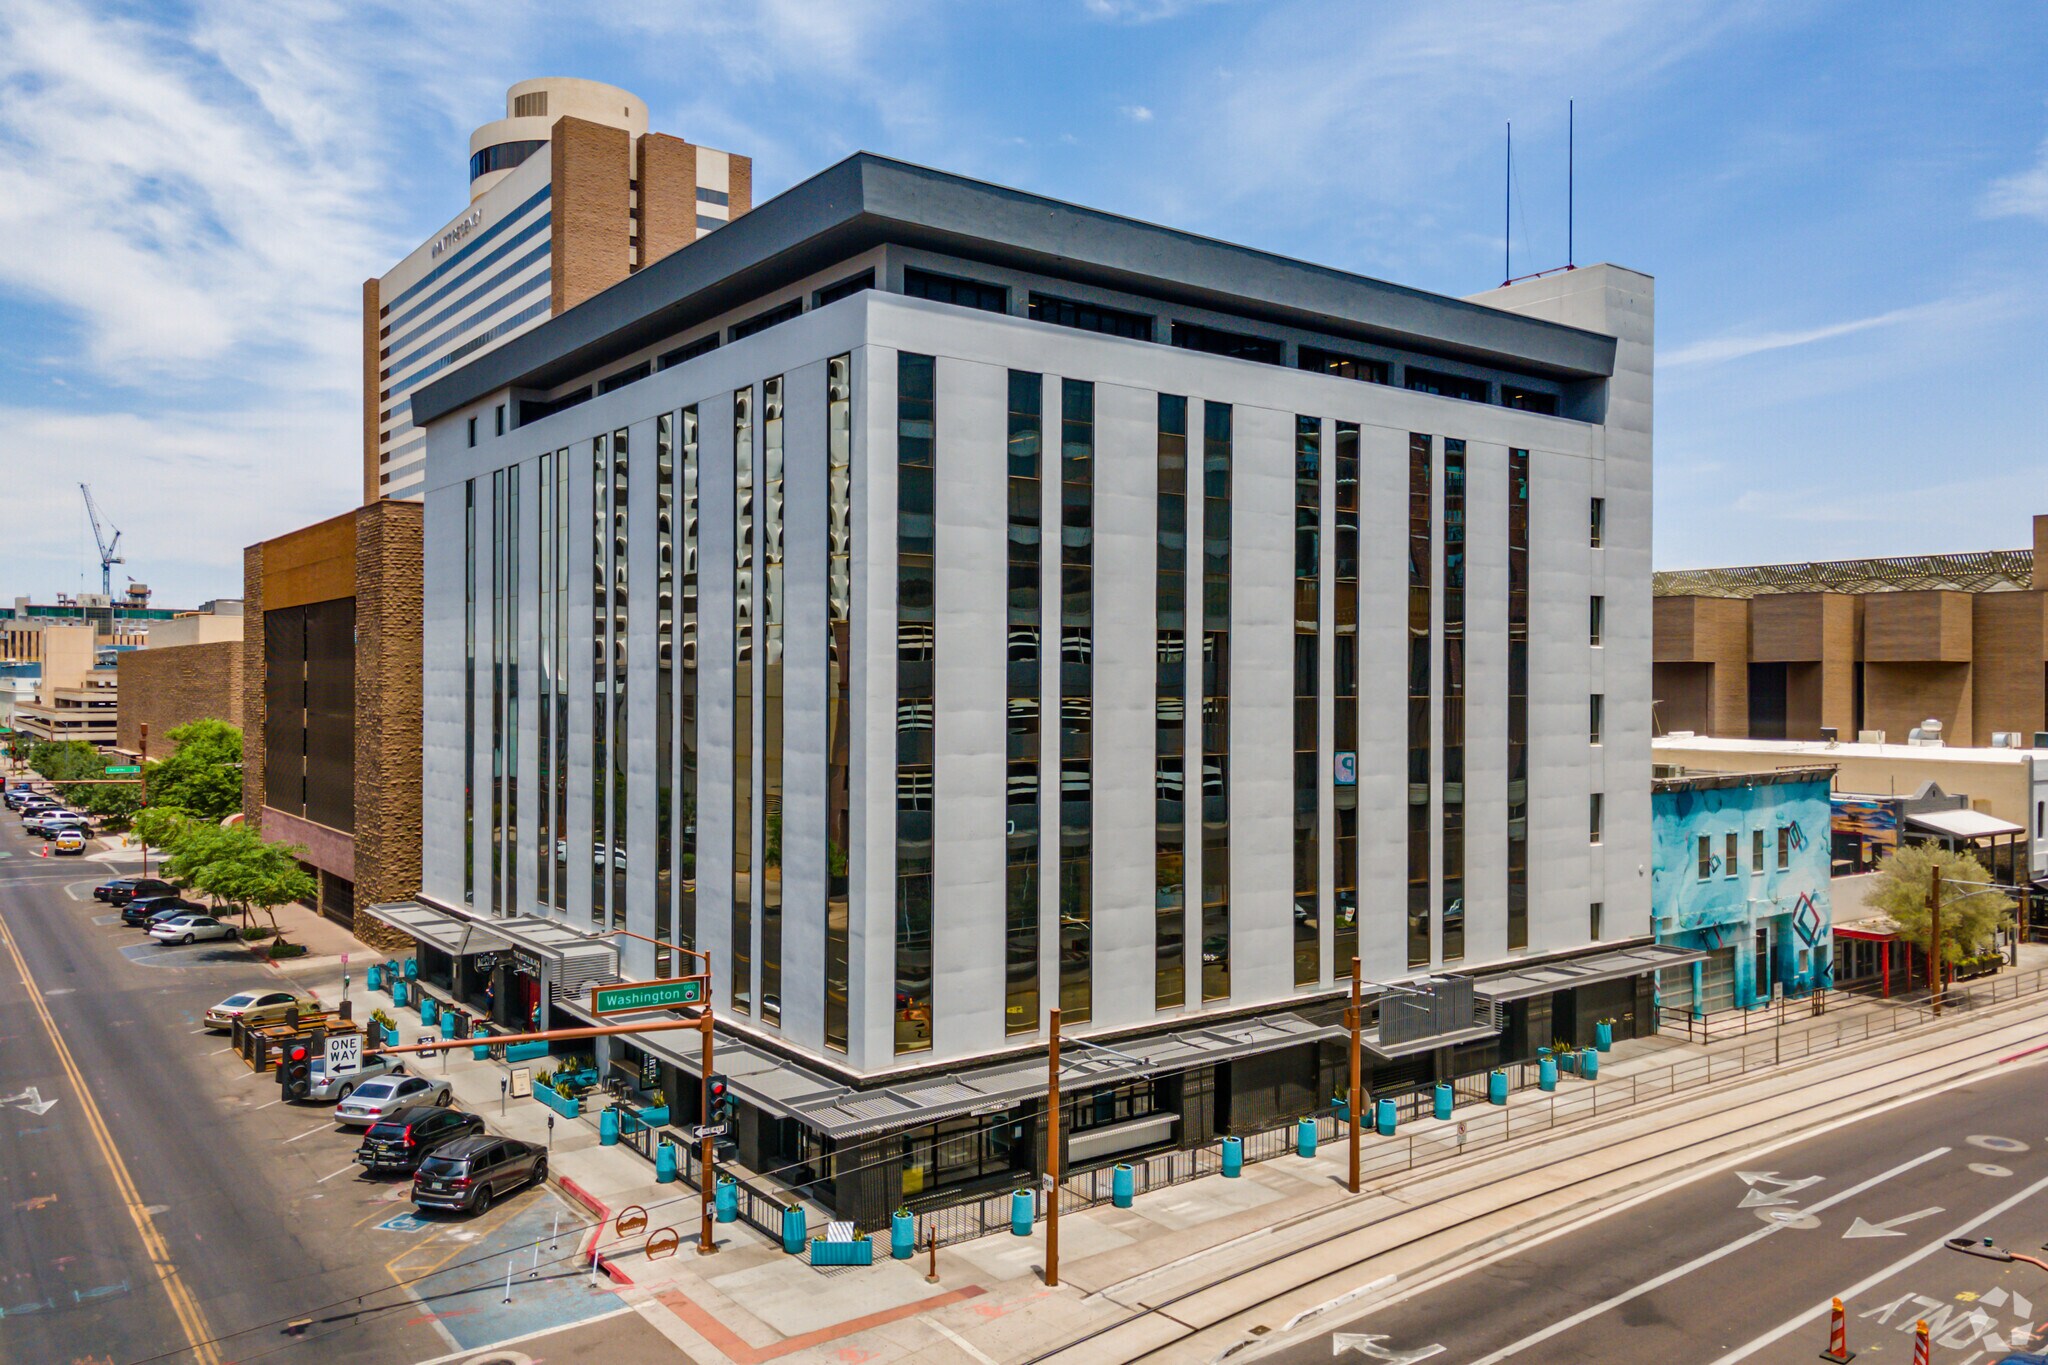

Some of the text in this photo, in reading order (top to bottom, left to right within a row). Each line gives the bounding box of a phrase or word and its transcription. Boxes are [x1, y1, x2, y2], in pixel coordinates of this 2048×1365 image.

[606, 989, 680, 1006] Washington
[331, 1038, 357, 1051] ONE
[330, 1049, 357, 1062] WAY
[1857, 1292, 1999, 1350] ONLY
